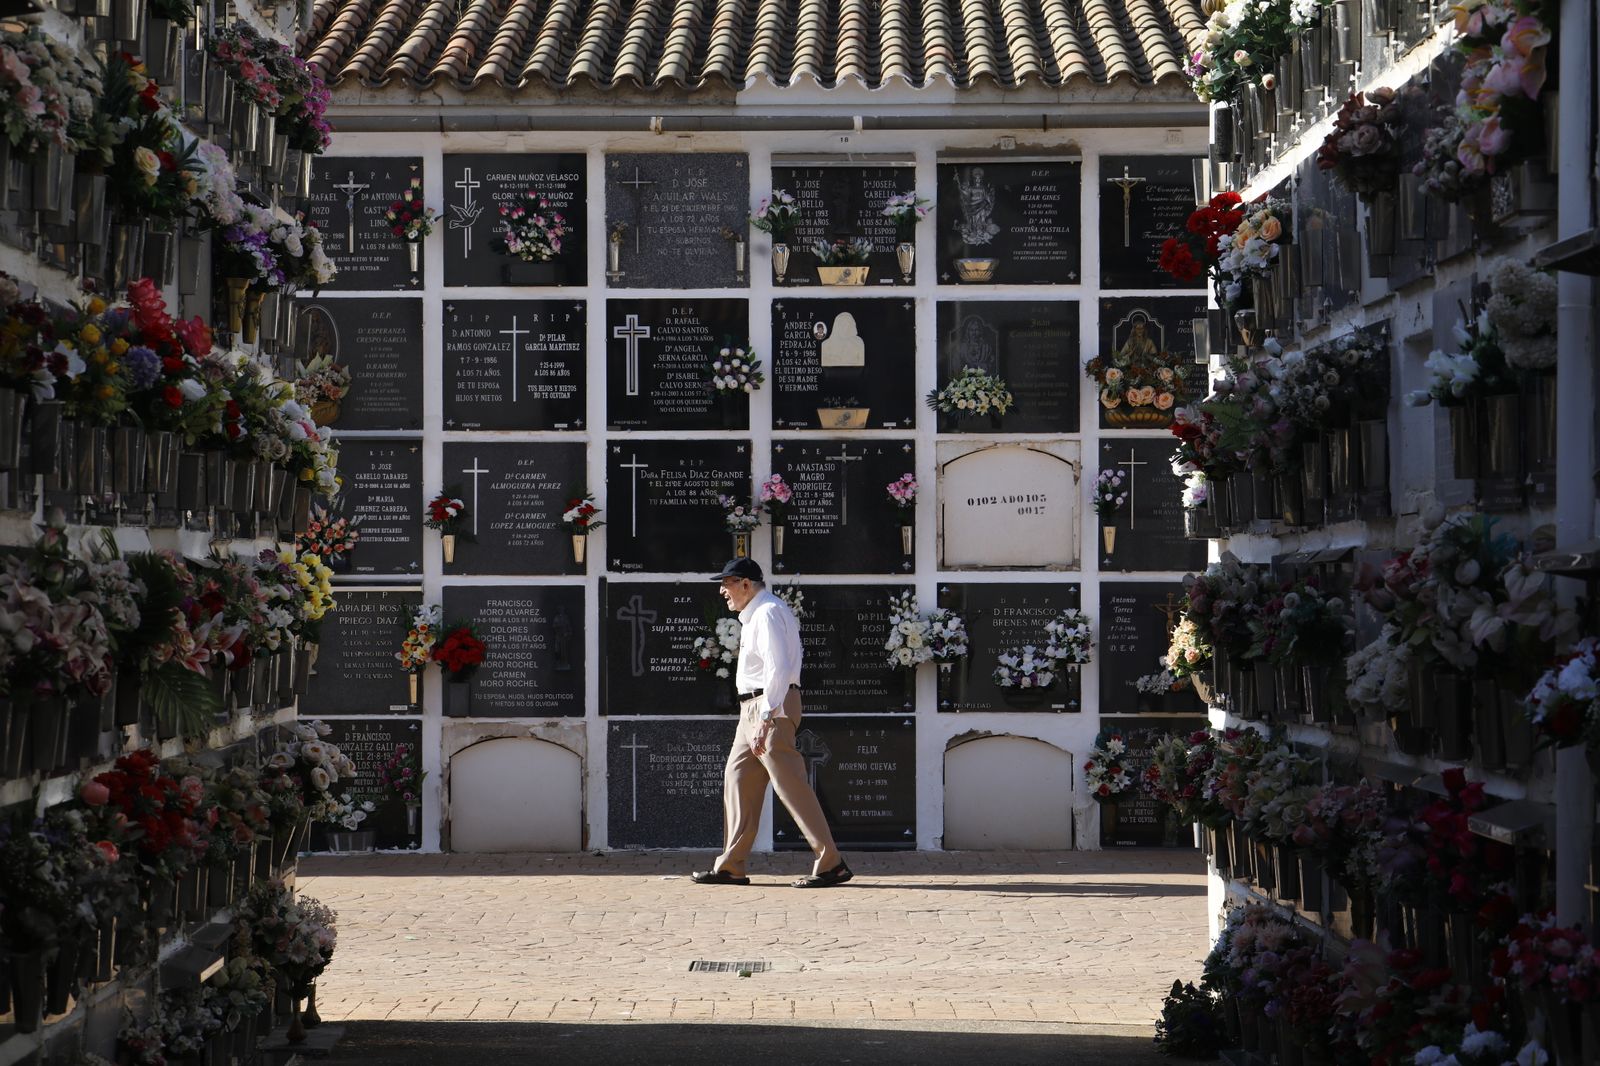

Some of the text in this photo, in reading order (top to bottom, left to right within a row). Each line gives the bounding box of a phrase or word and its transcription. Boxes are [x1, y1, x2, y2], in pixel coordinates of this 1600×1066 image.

[518, 172, 544, 181] MUÑOZ
[310, 193, 337, 201] RAFAEL
[548, 191, 574, 200] MUÑOZ
[460, 329, 492, 338] ANTONIO
[447, 343, 511, 351] RAMOS GONZALEZ
[780, 340, 817, 348] PEDRAJAS
[660, 470, 744, 479] FELISA DIAZ GRANDE
[792, 483, 832, 491] RODRIGUEZ
[376, 617, 398, 625] DIAZ
[352, 733, 391, 741] FRANCISCO
[857, 746, 878, 754] FELIX
[649, 754, 692, 763] RODRIGUEZ
